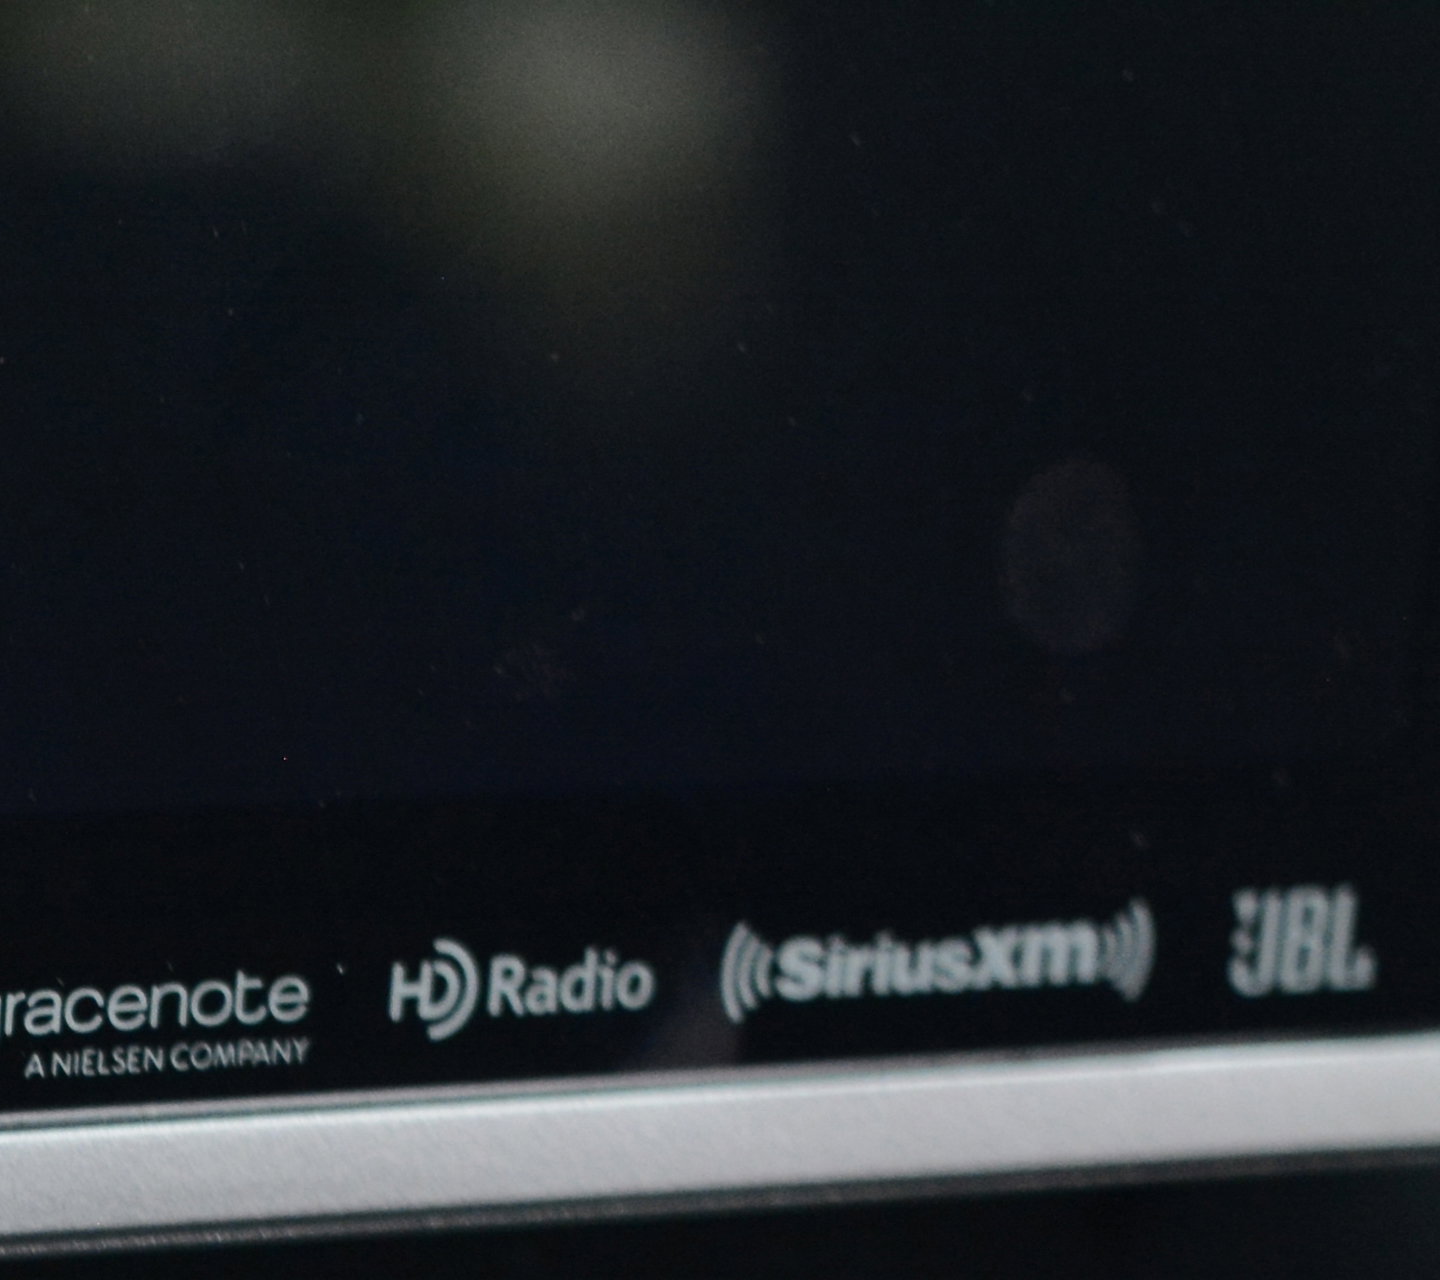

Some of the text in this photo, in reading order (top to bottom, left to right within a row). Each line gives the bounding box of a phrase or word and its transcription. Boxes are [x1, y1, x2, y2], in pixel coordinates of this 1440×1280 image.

[1229, 884, 1378, 1000] JBL
[487, 946, 655, 1018] Radio
[24, 1036, 310, 1079] A NIELSEN COMPANY
